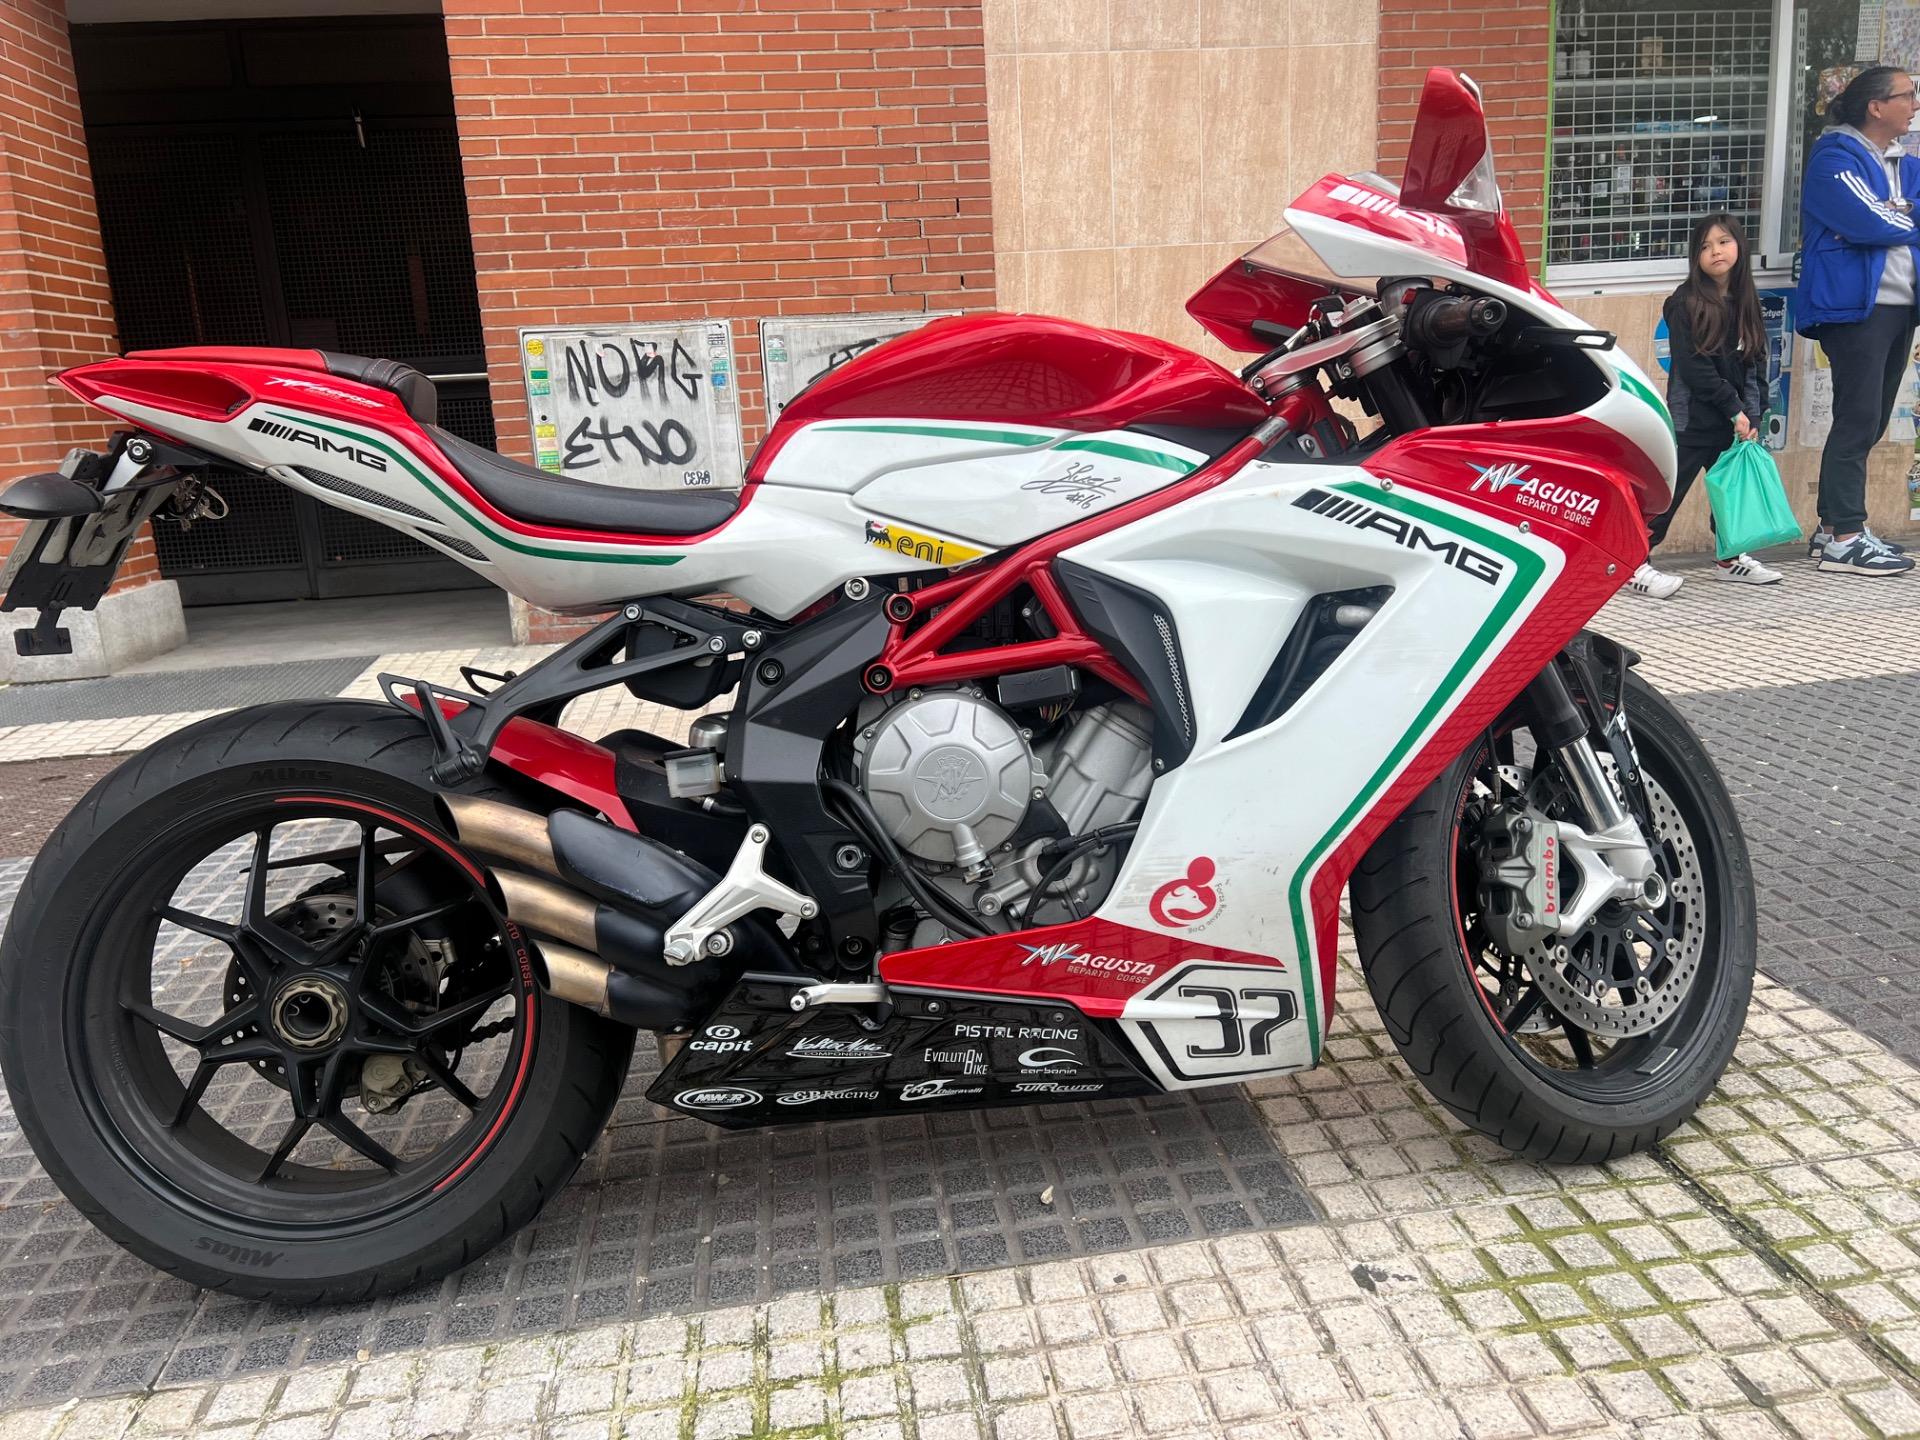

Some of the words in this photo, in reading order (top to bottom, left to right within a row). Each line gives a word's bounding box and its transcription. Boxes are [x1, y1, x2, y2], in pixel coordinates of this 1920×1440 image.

[288, 429, 387, 472] AMG
[1467, 462, 1532, 493] MV
[1518, 477, 1600, 516] AGUSTA
[1515, 493, 1558, 515] REPARTO
[1563, 509, 1593, 528] CORSE
[896, 535, 945, 565] eni
[1354, 511, 1504, 586] AMG
[1542, 836, 1557, 914] brembo
[516, 948, 534, 988] CORSE
[1066, 964, 1111, 979] REPARTO
[1116, 973, 1150, 985] CORSE
[1070, 953, 1156, 976] AGUSTA
[1178, 985, 1298, 1059] 37
[689, 1039, 754, 1054] capit
